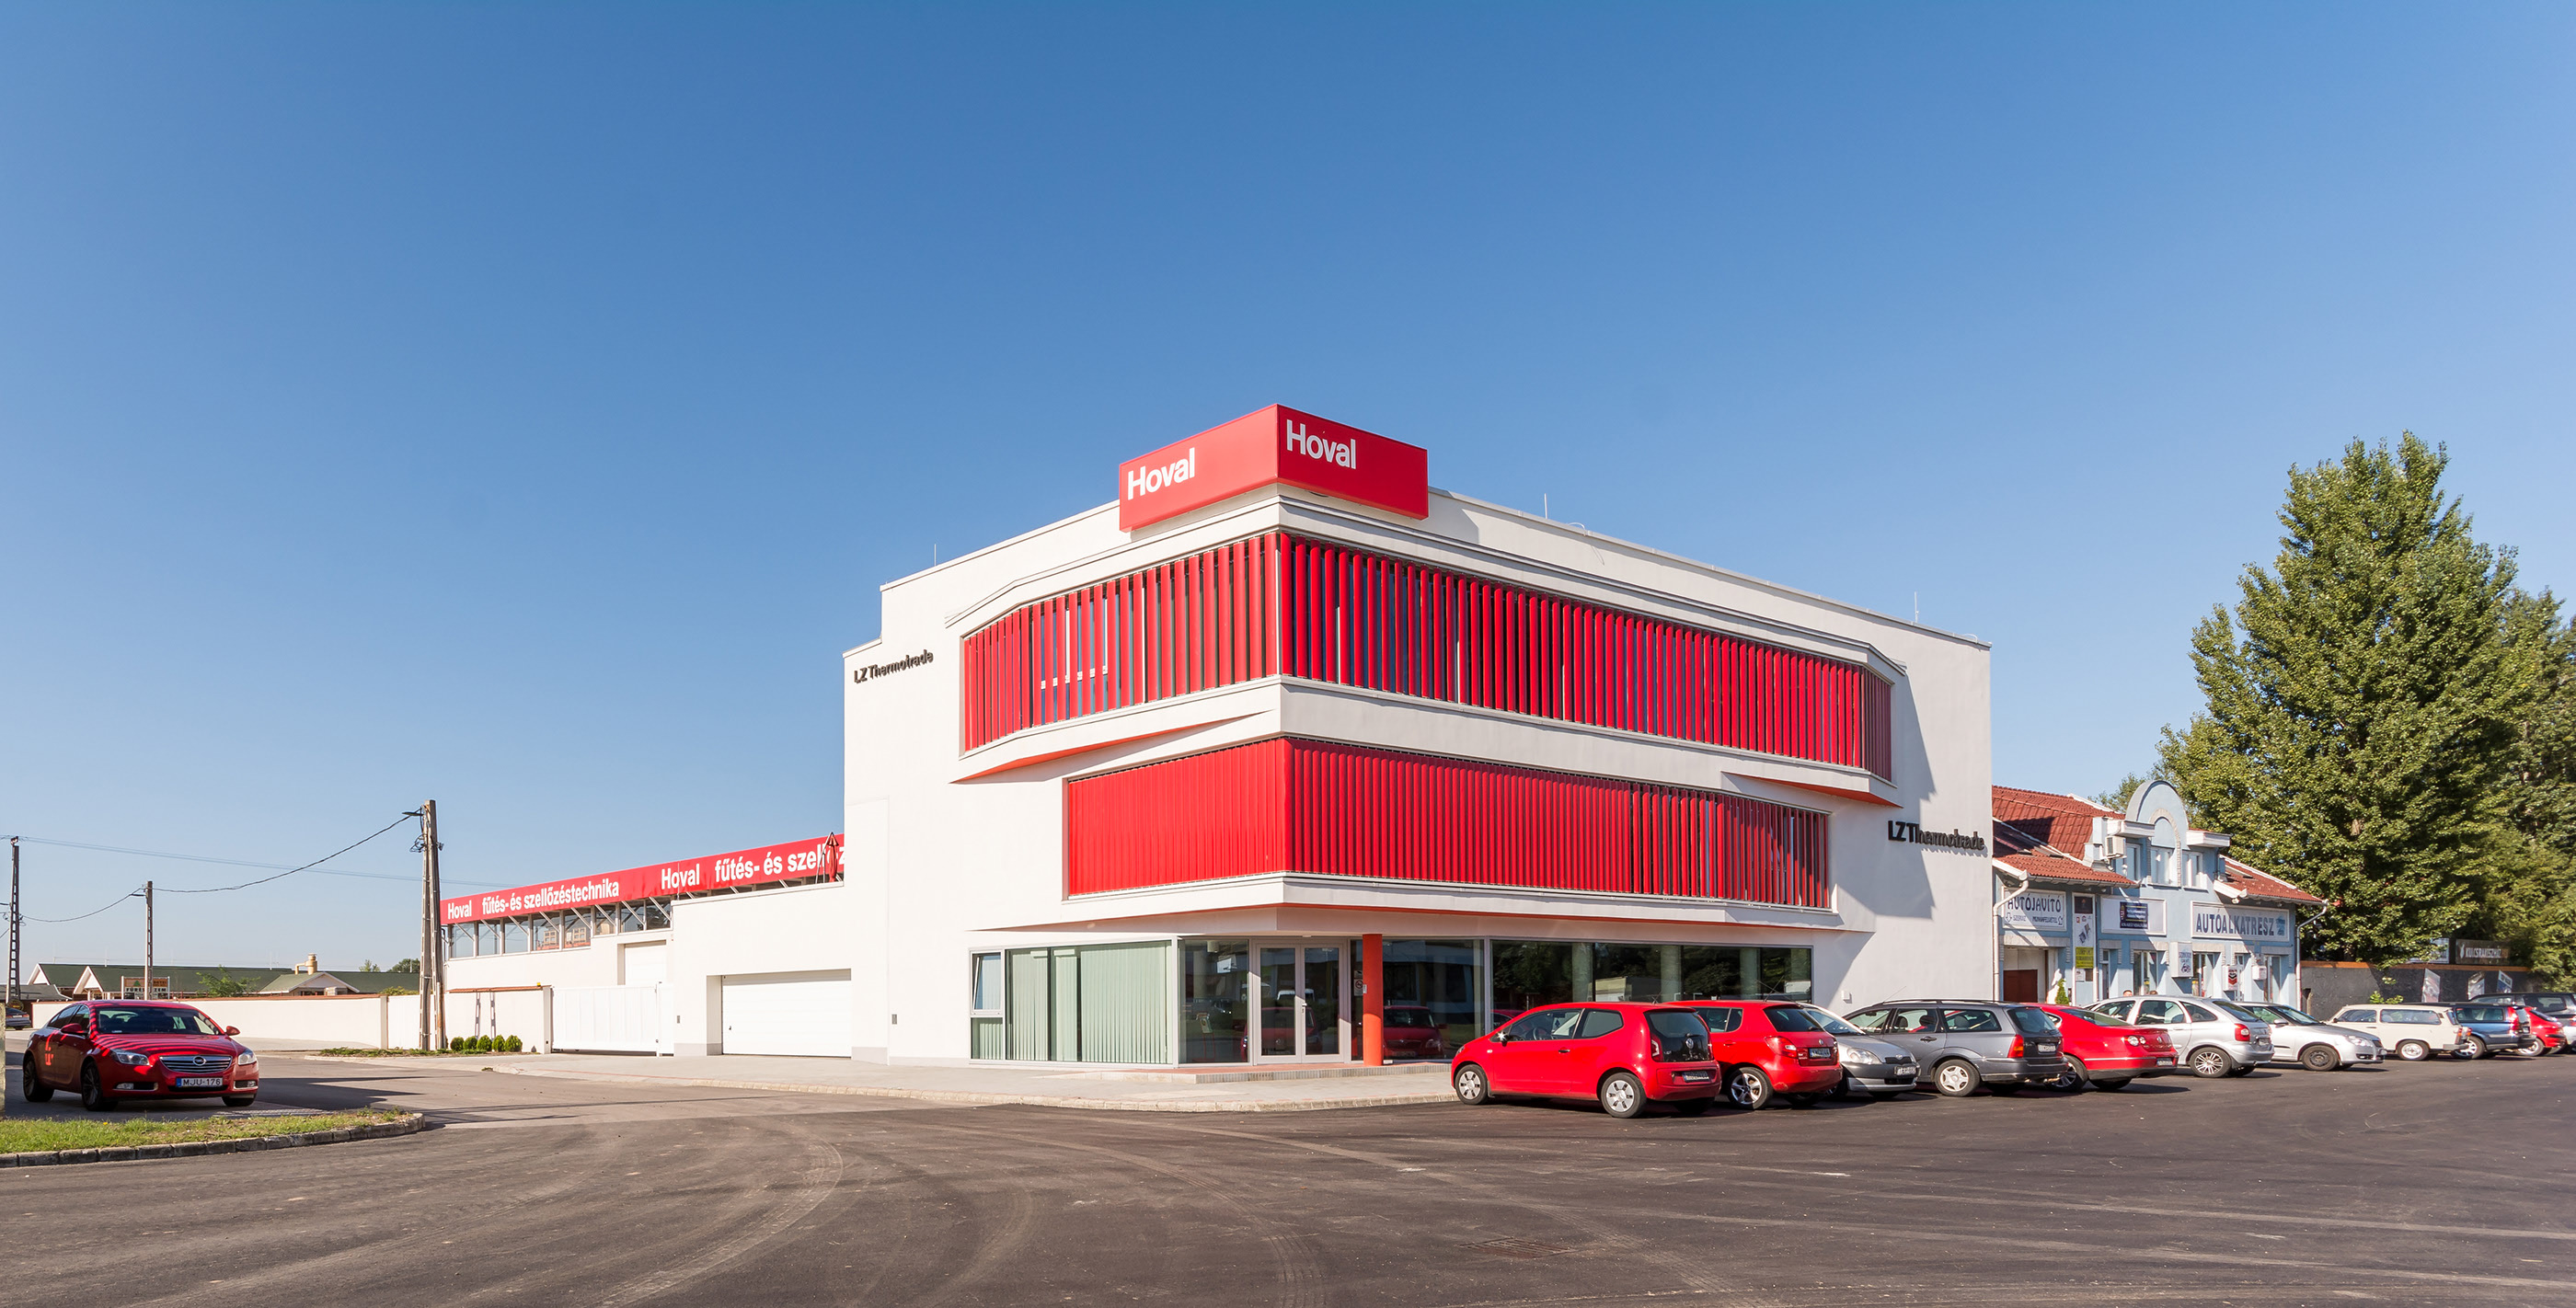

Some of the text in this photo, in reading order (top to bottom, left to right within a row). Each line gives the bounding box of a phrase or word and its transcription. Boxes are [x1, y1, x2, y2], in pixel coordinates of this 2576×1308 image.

[1287, 419, 1356, 469] Hoval
[1127, 447, 1195, 500] Hoval
[854, 648, 934, 684] LZ Thermotrade
[1888, 820, 1985, 851] LZ Thermotrade
[661, 864, 699, 889] Hoval
[763, 852, 783, 875] és
[447, 900, 472, 920] Hoval
[523, 878, 619, 910] szellőzéstechnika
[2007, 893, 2061, 912] AUTÓJAVÍTÓ
[2196, 909, 2274, 936] AUTÓALKATRÉSZ
